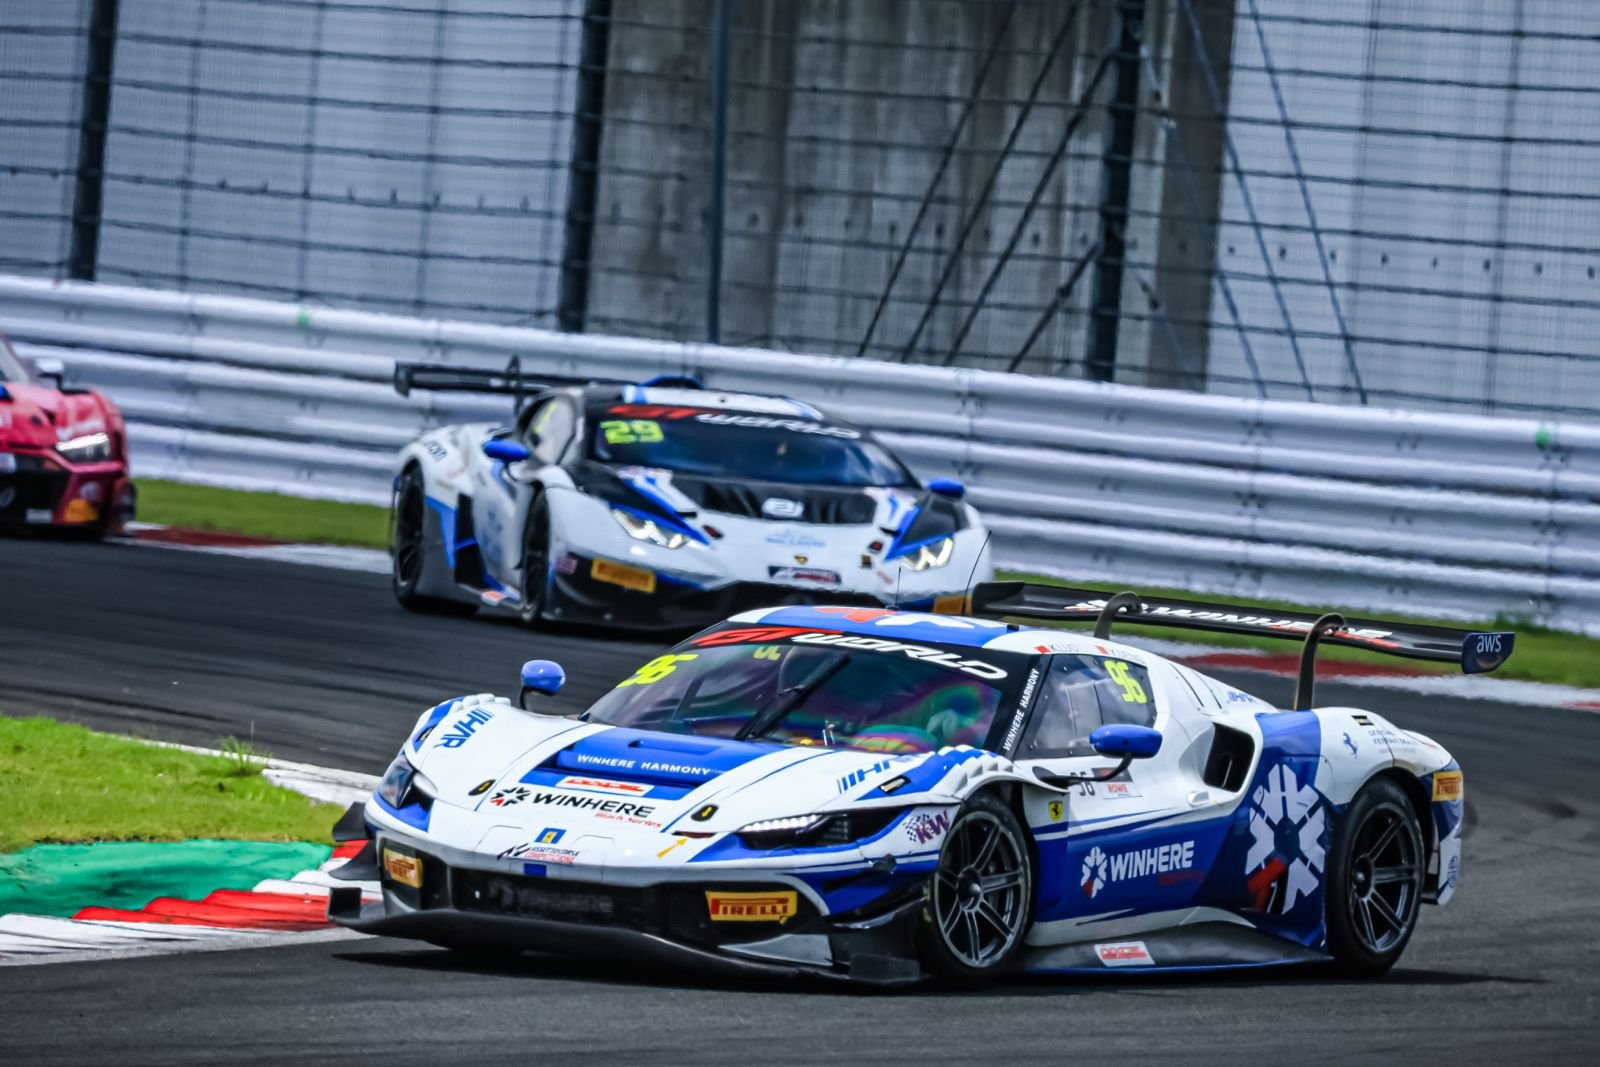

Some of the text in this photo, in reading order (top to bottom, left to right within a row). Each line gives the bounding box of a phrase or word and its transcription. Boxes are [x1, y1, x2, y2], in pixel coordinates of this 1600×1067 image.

[600, 419, 665, 445] 29
[790, 632, 1008, 680] WORLD
[1476, 634, 1502, 654] aws
[1105, 660, 1148, 705] 96
[1003, 668, 1040, 751] WINHERE HARMONY
[577, 753, 711, 776] WINHERE HARMONY
[532, 792, 656, 819] WINHERE
[1110, 840, 1195, 882] WINHERE
[710, 897, 789, 916] PIRELLI
